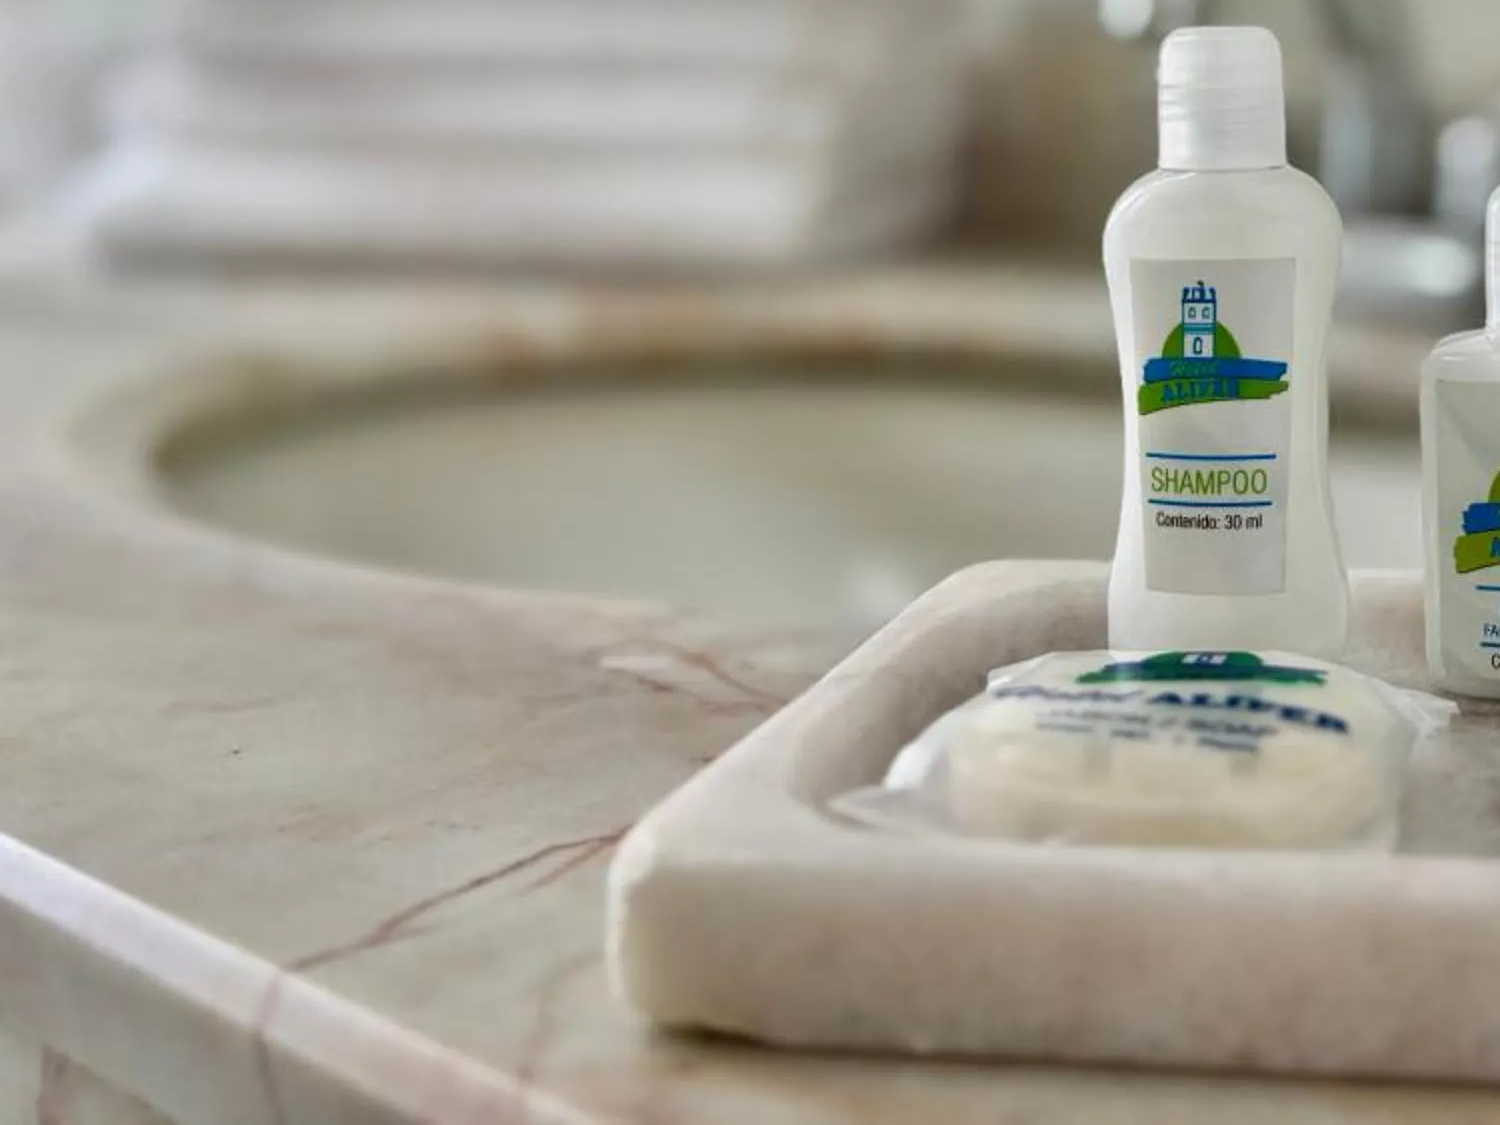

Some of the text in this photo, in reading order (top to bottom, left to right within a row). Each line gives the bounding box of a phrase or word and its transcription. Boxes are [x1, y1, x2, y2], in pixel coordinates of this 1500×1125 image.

[1161, 378, 1240, 403] ALIFER
[1150, 466, 1268, 496] SHAMPOO
[1155, 511, 1263, 530] Contenido: 30 ml
